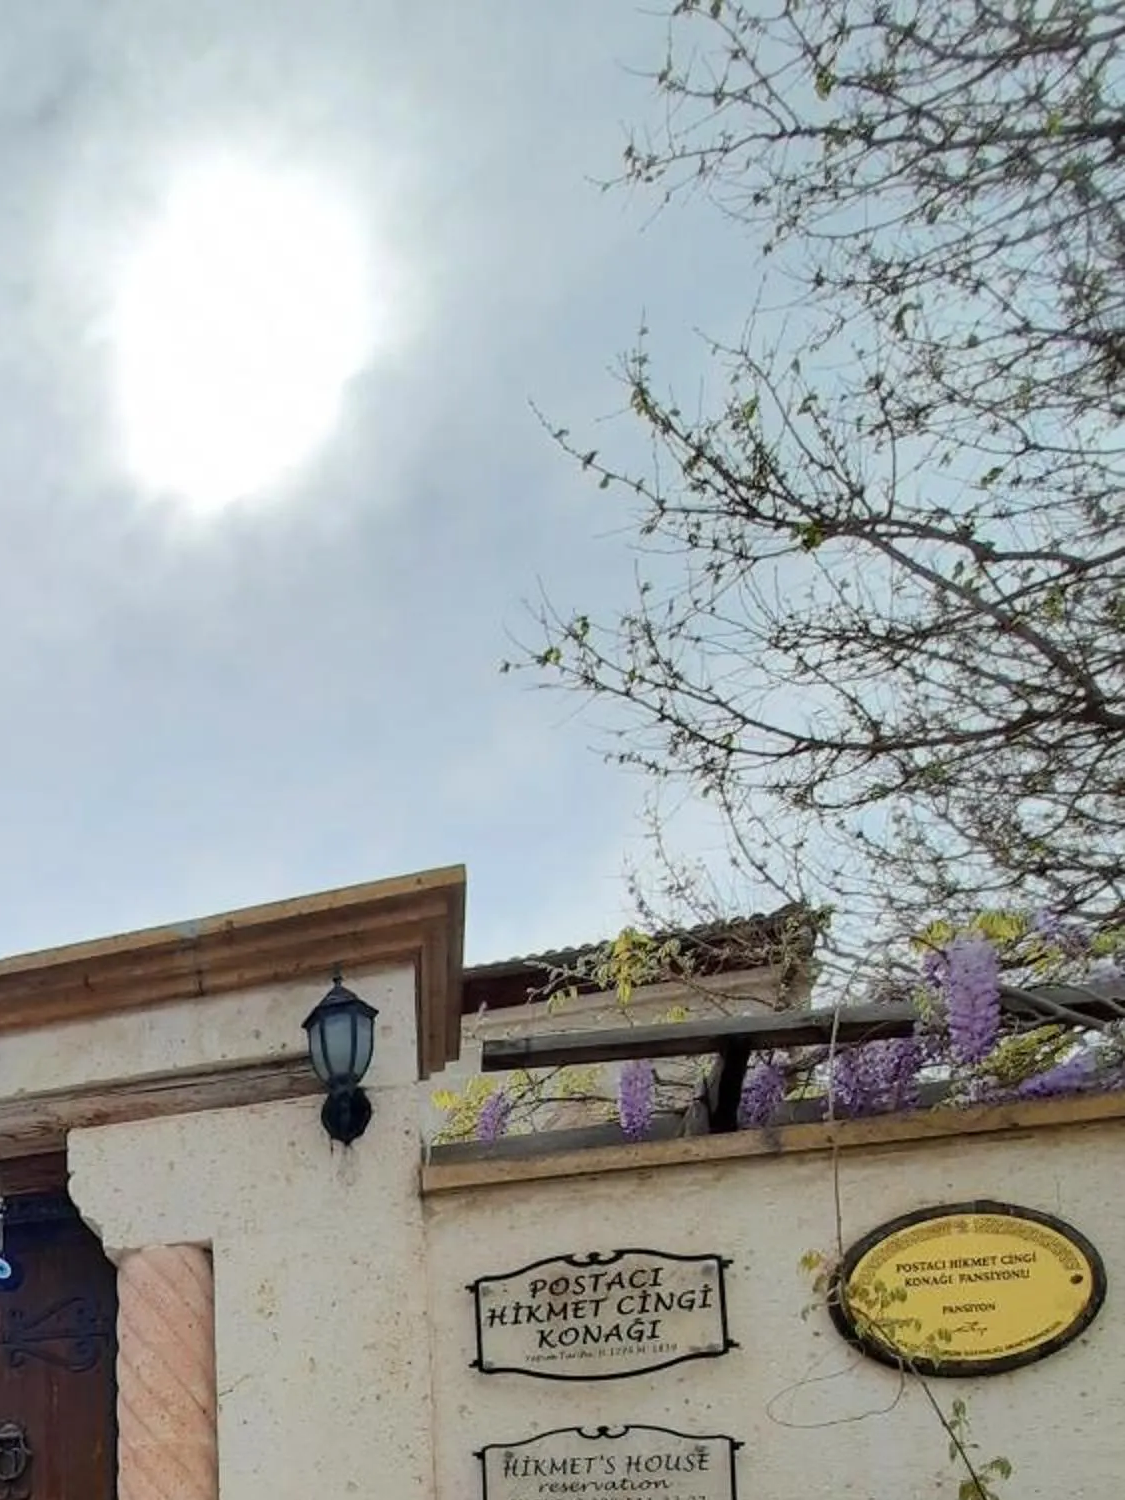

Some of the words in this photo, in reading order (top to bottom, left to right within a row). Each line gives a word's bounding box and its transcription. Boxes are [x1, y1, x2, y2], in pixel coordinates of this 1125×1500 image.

[529, 1266, 664, 1298] POSTACI
[486, 1297, 610, 1328] HİKMET
[616, 1283, 713, 1316] CİNGİ
[536, 1318, 663, 1349] KONAĞI
[504, 1454, 616, 1478] HİKMET'S
[626, 1452, 711, 1474] HOUSE
[538, 1477, 670, 1493] reservation
